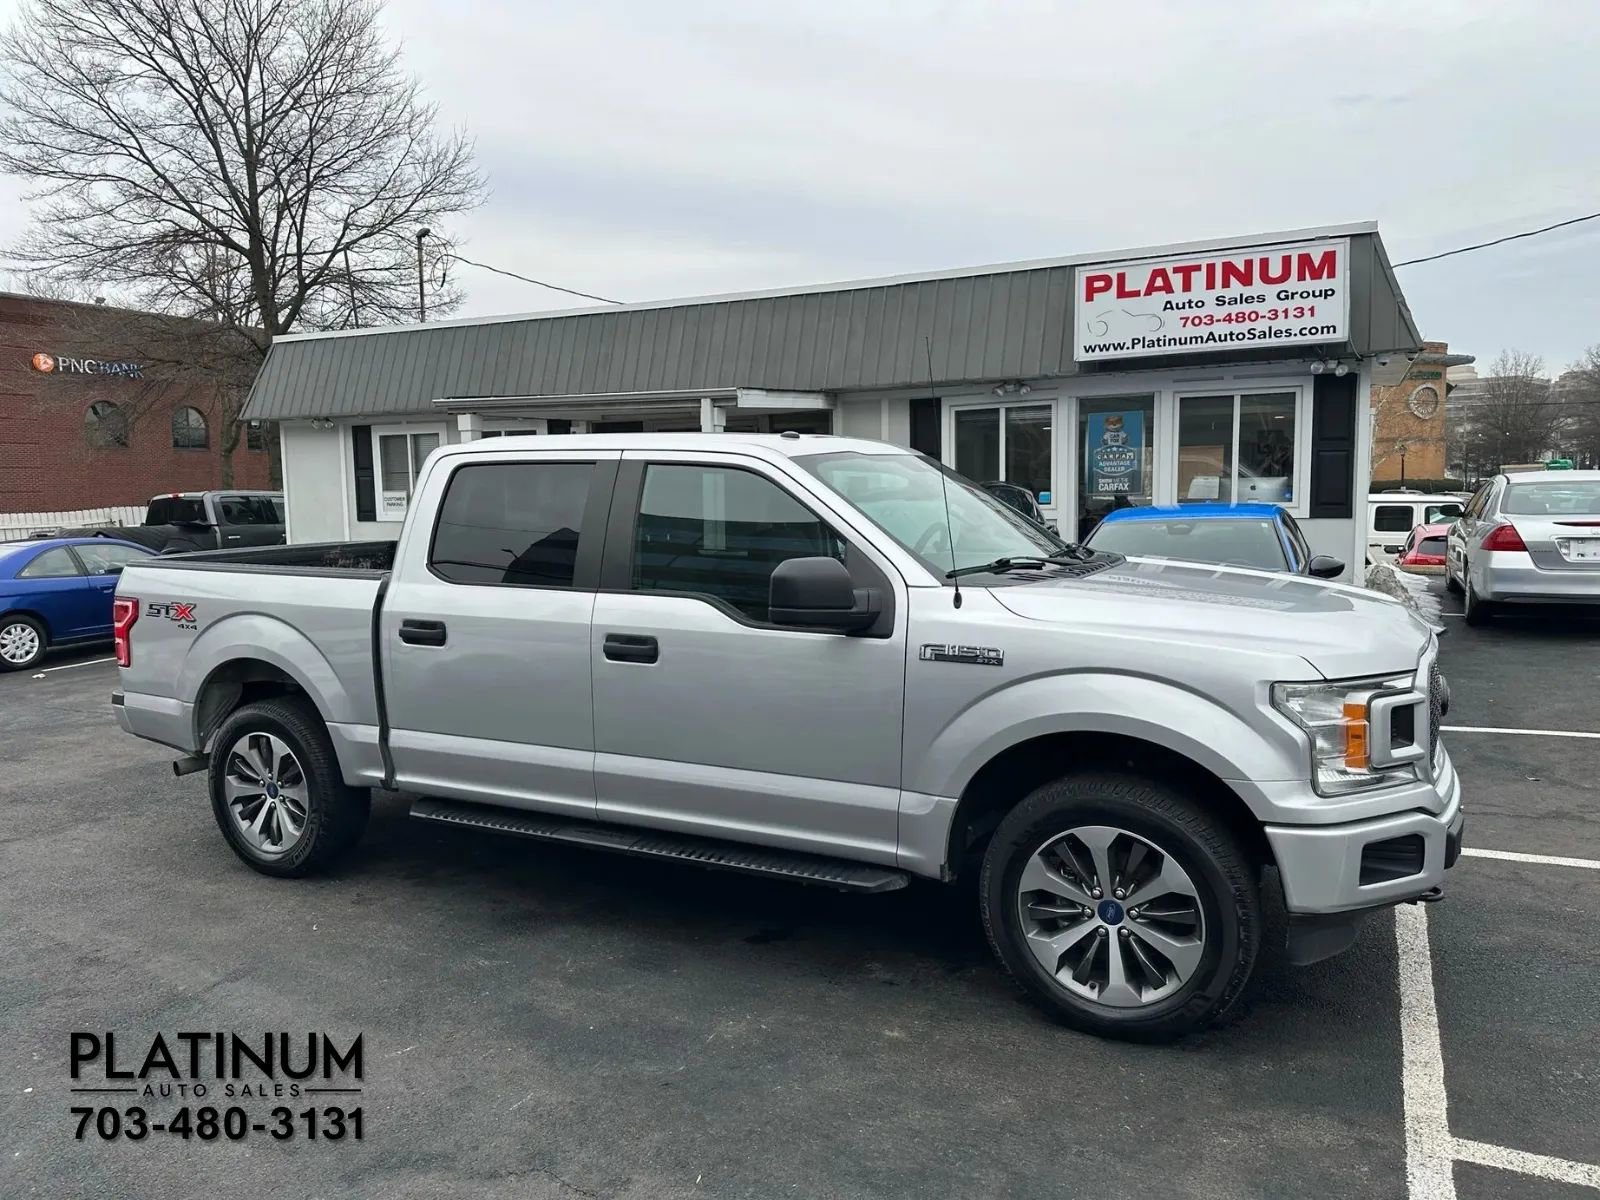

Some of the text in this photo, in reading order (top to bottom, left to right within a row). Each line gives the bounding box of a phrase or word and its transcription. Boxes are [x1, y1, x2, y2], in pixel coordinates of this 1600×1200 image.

[1085, 250, 1337, 302] PLATINUM
[1162, 287, 1336, 312] Auto Sales Group
[1179, 305, 1316, 328] 703-480-3131
[1083, 324, 1337, 354] www.PlatinumAutoSales.com
[1098, 483, 1129, 491] CARFAX
[145, 602, 198, 622] STX
